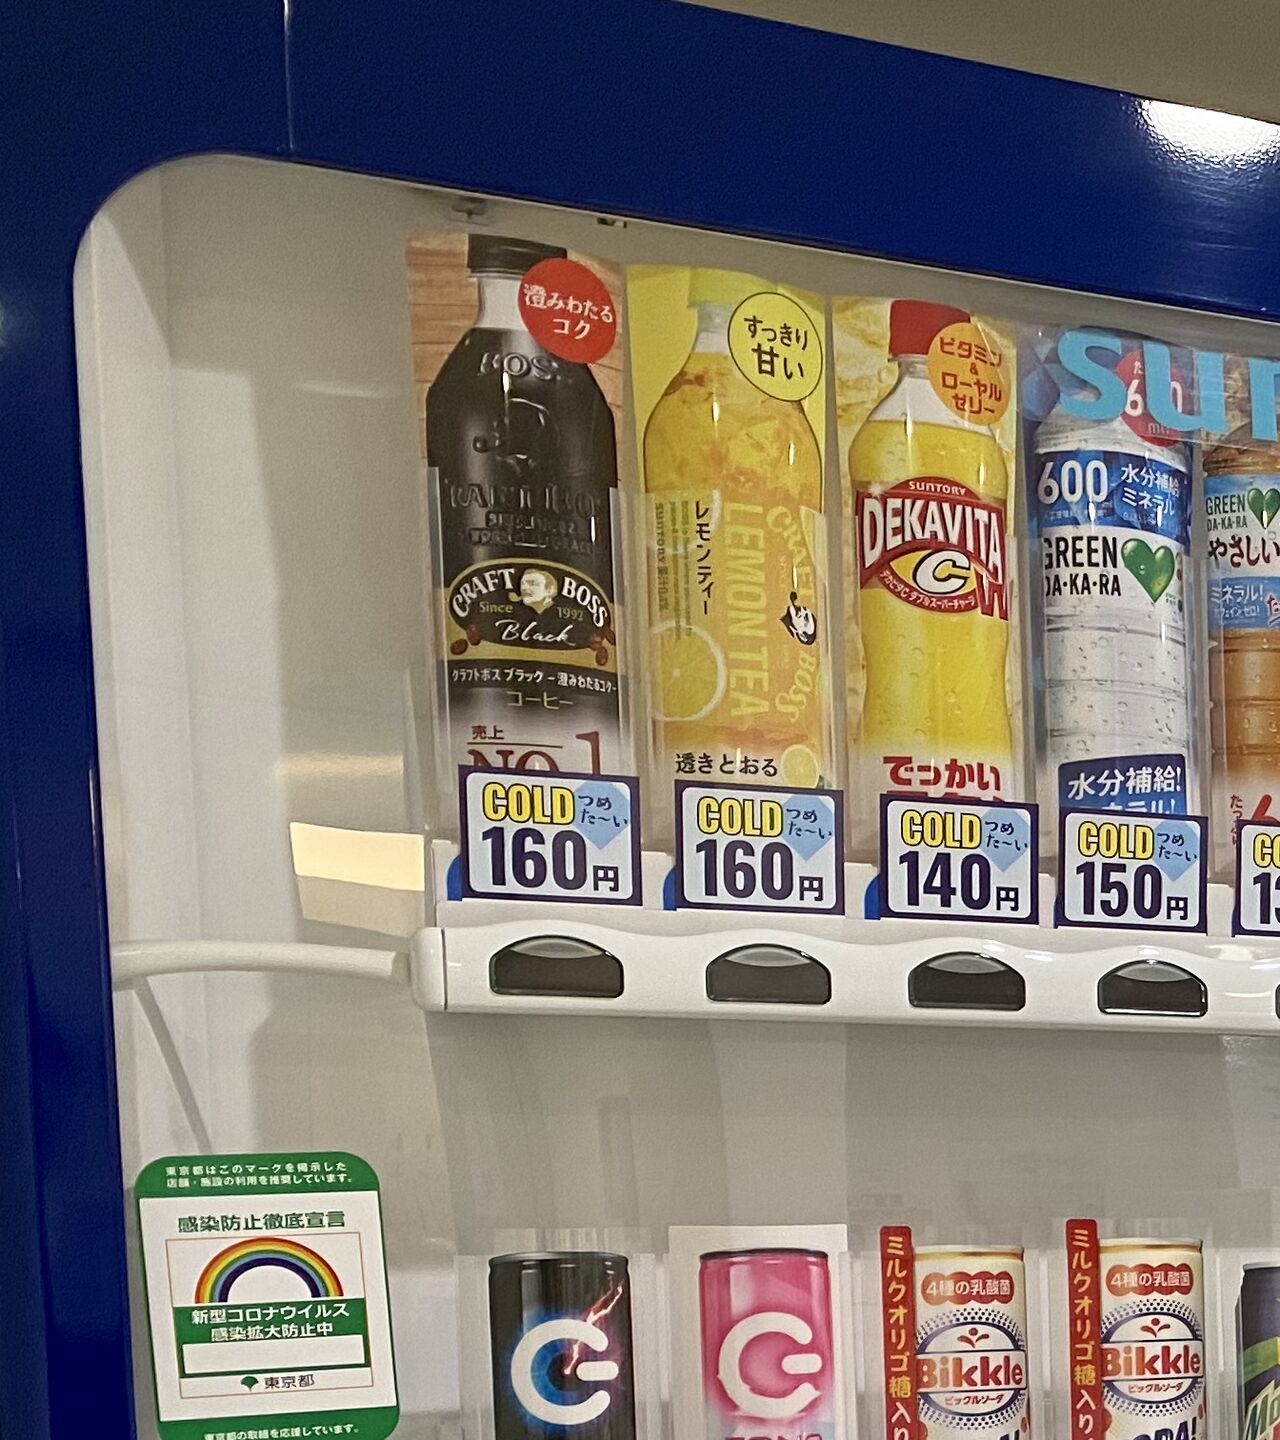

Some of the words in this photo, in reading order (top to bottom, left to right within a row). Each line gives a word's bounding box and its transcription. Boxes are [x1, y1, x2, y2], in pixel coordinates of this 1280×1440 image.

[523, 283, 614, 323] 澄みわたる
[553, 319, 590, 339] コク
[743, 316, 809, 349] すっきり
[752, 345, 805, 380] 甘い
[939, 336, 1001, 368] ビタミン
[941, 372, 1002, 402] ローヤル
[952, 394, 995, 414] ゼリー
[1037, 459, 1108, 505] 600
[1122, 486, 1174, 516] ミネラル
[864, 496, 1003, 584] DEKAVITA
[1208, 535, 1280, 569] やさしい
[695, 501, 714, 615] レモンティー
[724, 503, 767, 638] LEMON
[452, 568, 516, 618] CRAFT
[562, 577, 608, 627] BOSS
[479, 601, 514, 613] Since
[557, 607, 583, 620] 1992
[495, 619, 576, 646] Black
[729, 646, 769, 716] TEA
[507, 691, 573, 709] コーヒー
[675, 752, 778, 777] 透きとおる
[884, 755, 1001, 792] でっかい
[1067, 766, 1182, 800] 水分補給!
[482, 780, 575, 825] COLD
[1078, 821, 1154, 859] COLD
[481, 826, 620, 893] 160円
[900, 849, 1020, 912] 140円
[1076, 861, 1189, 922] 150円
[178, 1211, 346, 1233] 感染防止徹底宣言
[926, 1278, 1011, 1297] 4種の乳酸菌
[191, 1302, 350, 1325] 新型コロナウイルス
[211, 1322, 333, 1342] 感染拡大防止中
[264, 1374, 315, 1389] 東京都
[918, 1354, 1023, 1389] Bikkle
